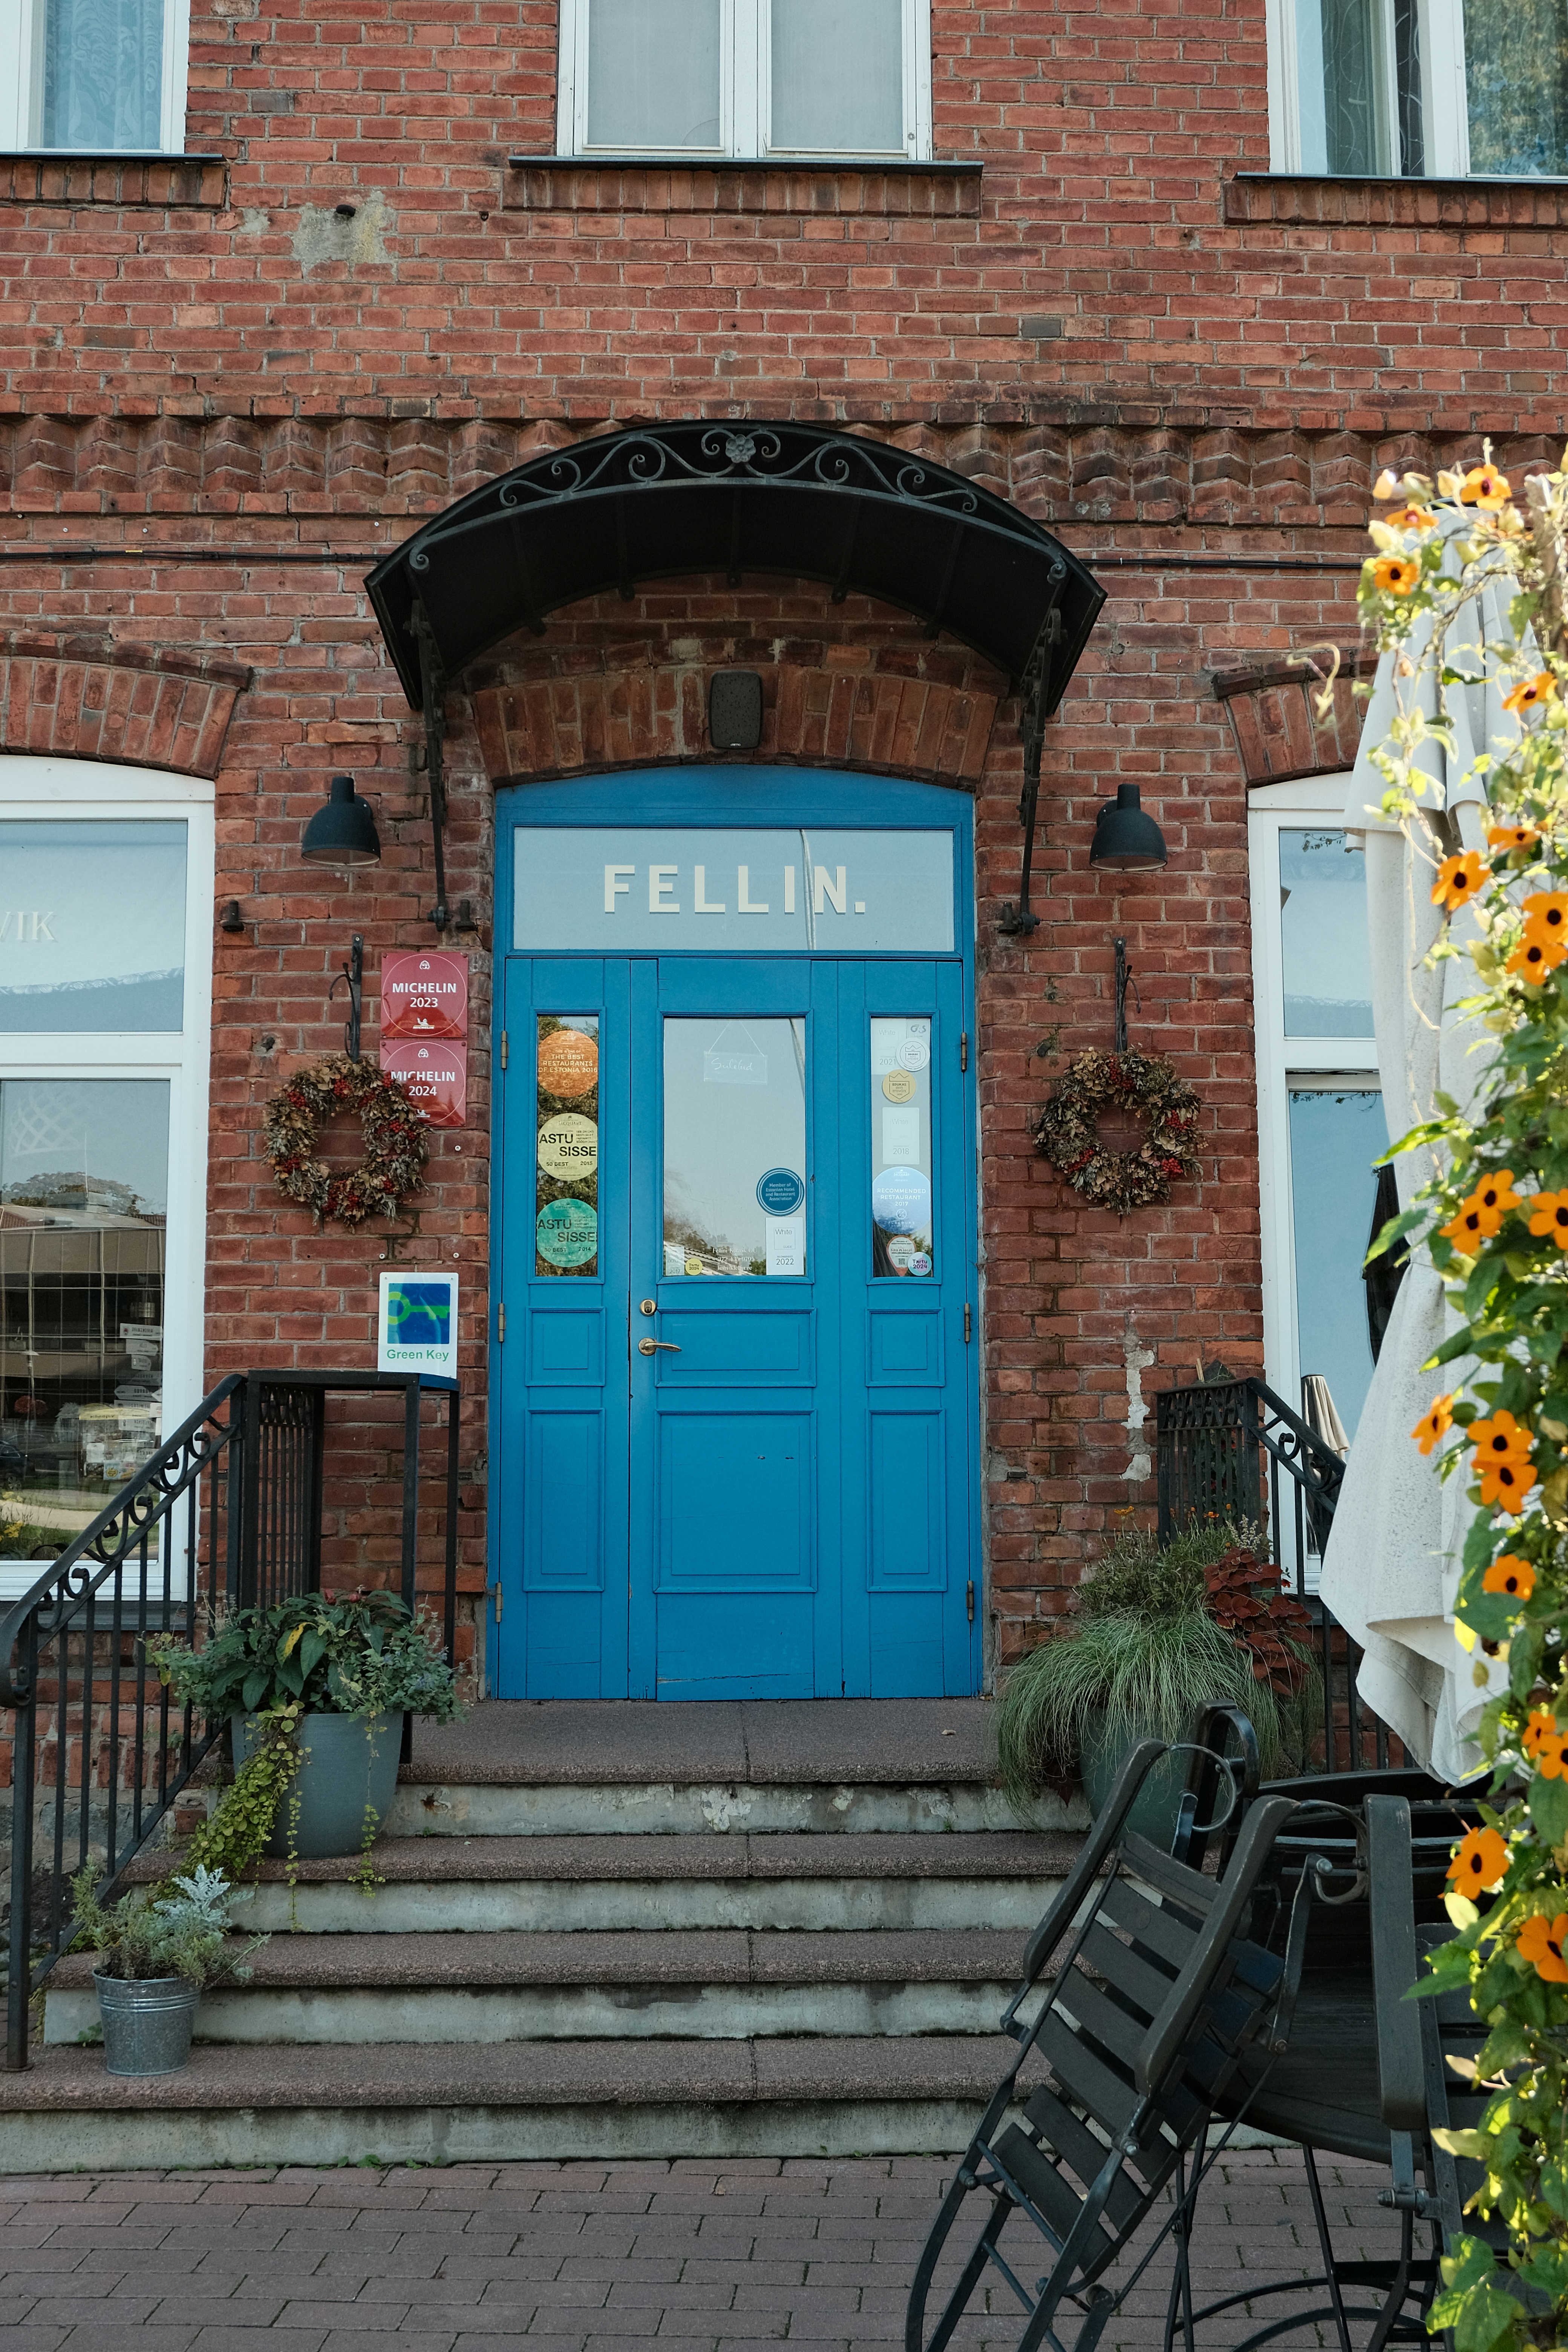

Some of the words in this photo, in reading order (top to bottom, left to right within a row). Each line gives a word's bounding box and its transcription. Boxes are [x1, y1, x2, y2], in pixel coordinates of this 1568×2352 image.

[605, 865, 865, 914] FELLIN.
[392, 983, 456, 993] MICHELIN
[410, 997, 438, 1008] 2023
[391, 1071, 455, 1081] MICHELIN
[408, 1086, 437, 1096] 2024
[539, 1133, 573, 1144] ASTU
[559, 1146, 597, 1156] SISSE
[537, 1219, 571, 1230] ASTU
[557, 1232, 595, 1242] SISSE
[387, 1349, 423, 1359] Green
[427, 1350, 449, 1362] Key
